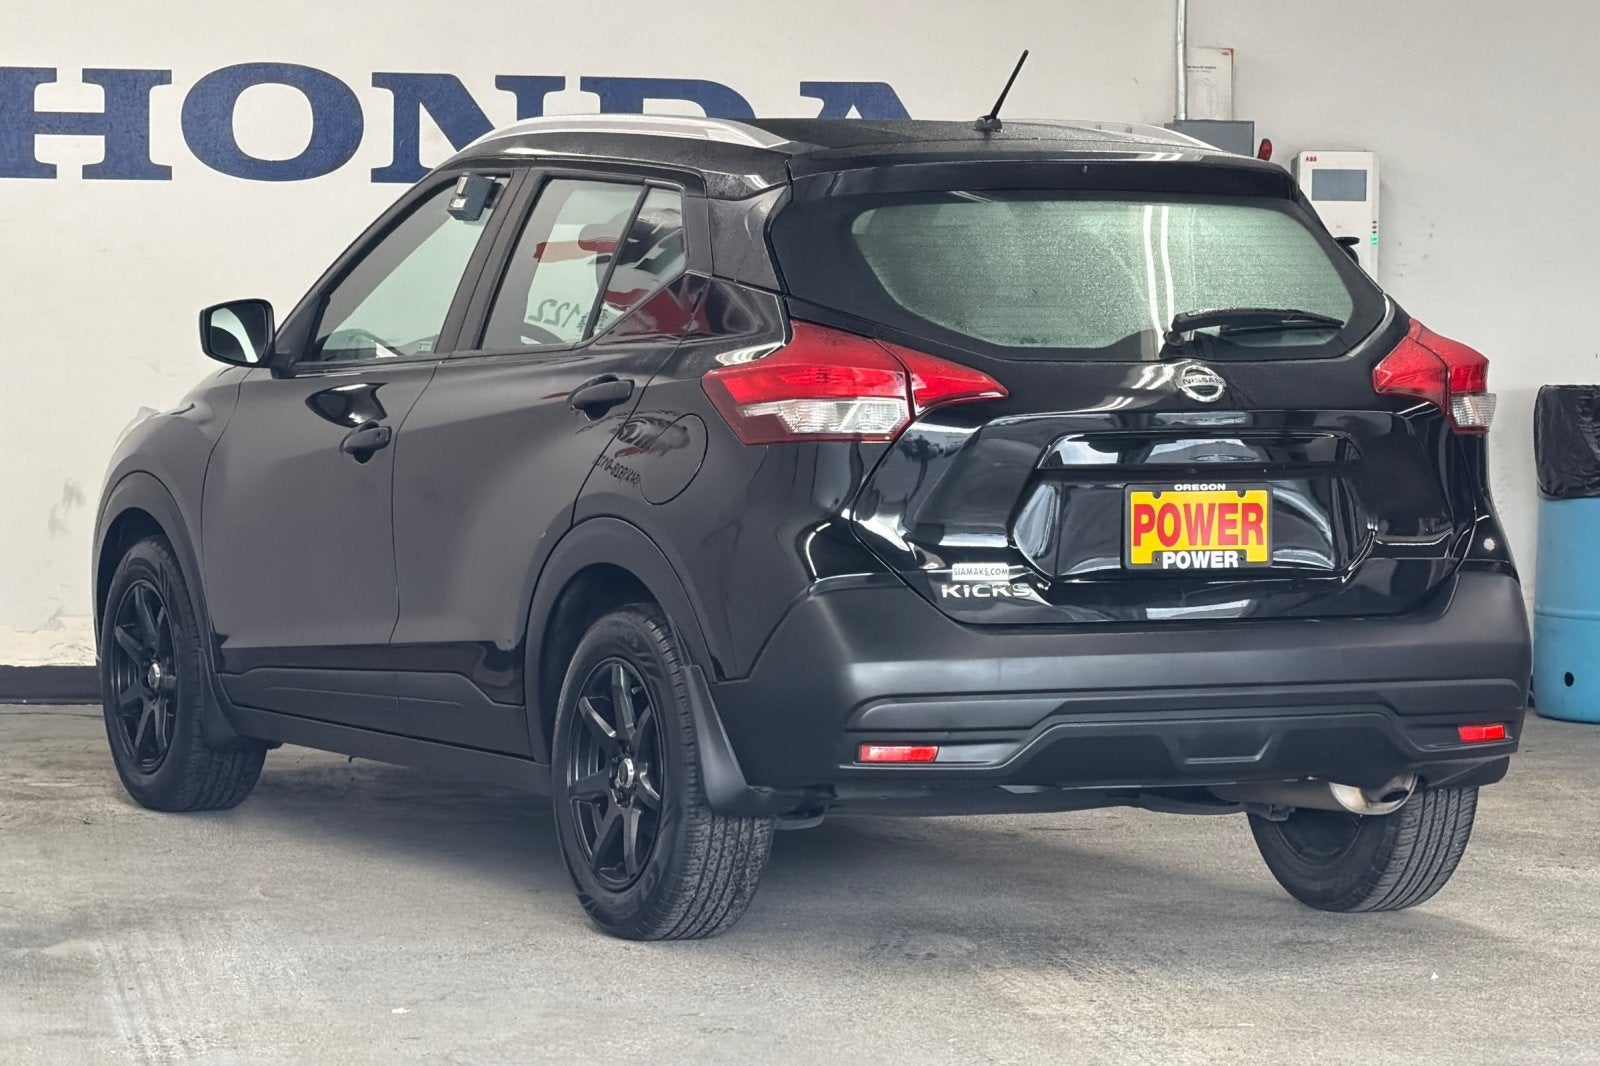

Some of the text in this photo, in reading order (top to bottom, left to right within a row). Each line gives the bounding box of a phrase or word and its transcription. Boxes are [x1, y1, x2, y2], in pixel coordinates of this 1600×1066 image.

[1173, 483, 1226, 491] OREGON
[1133, 502, 1264, 547] POWER
[1162, 550, 1239, 569] POWER
[953, 567, 1008, 577] SIAMAKS.COM
[941, 582, 1031, 598] KICKS
